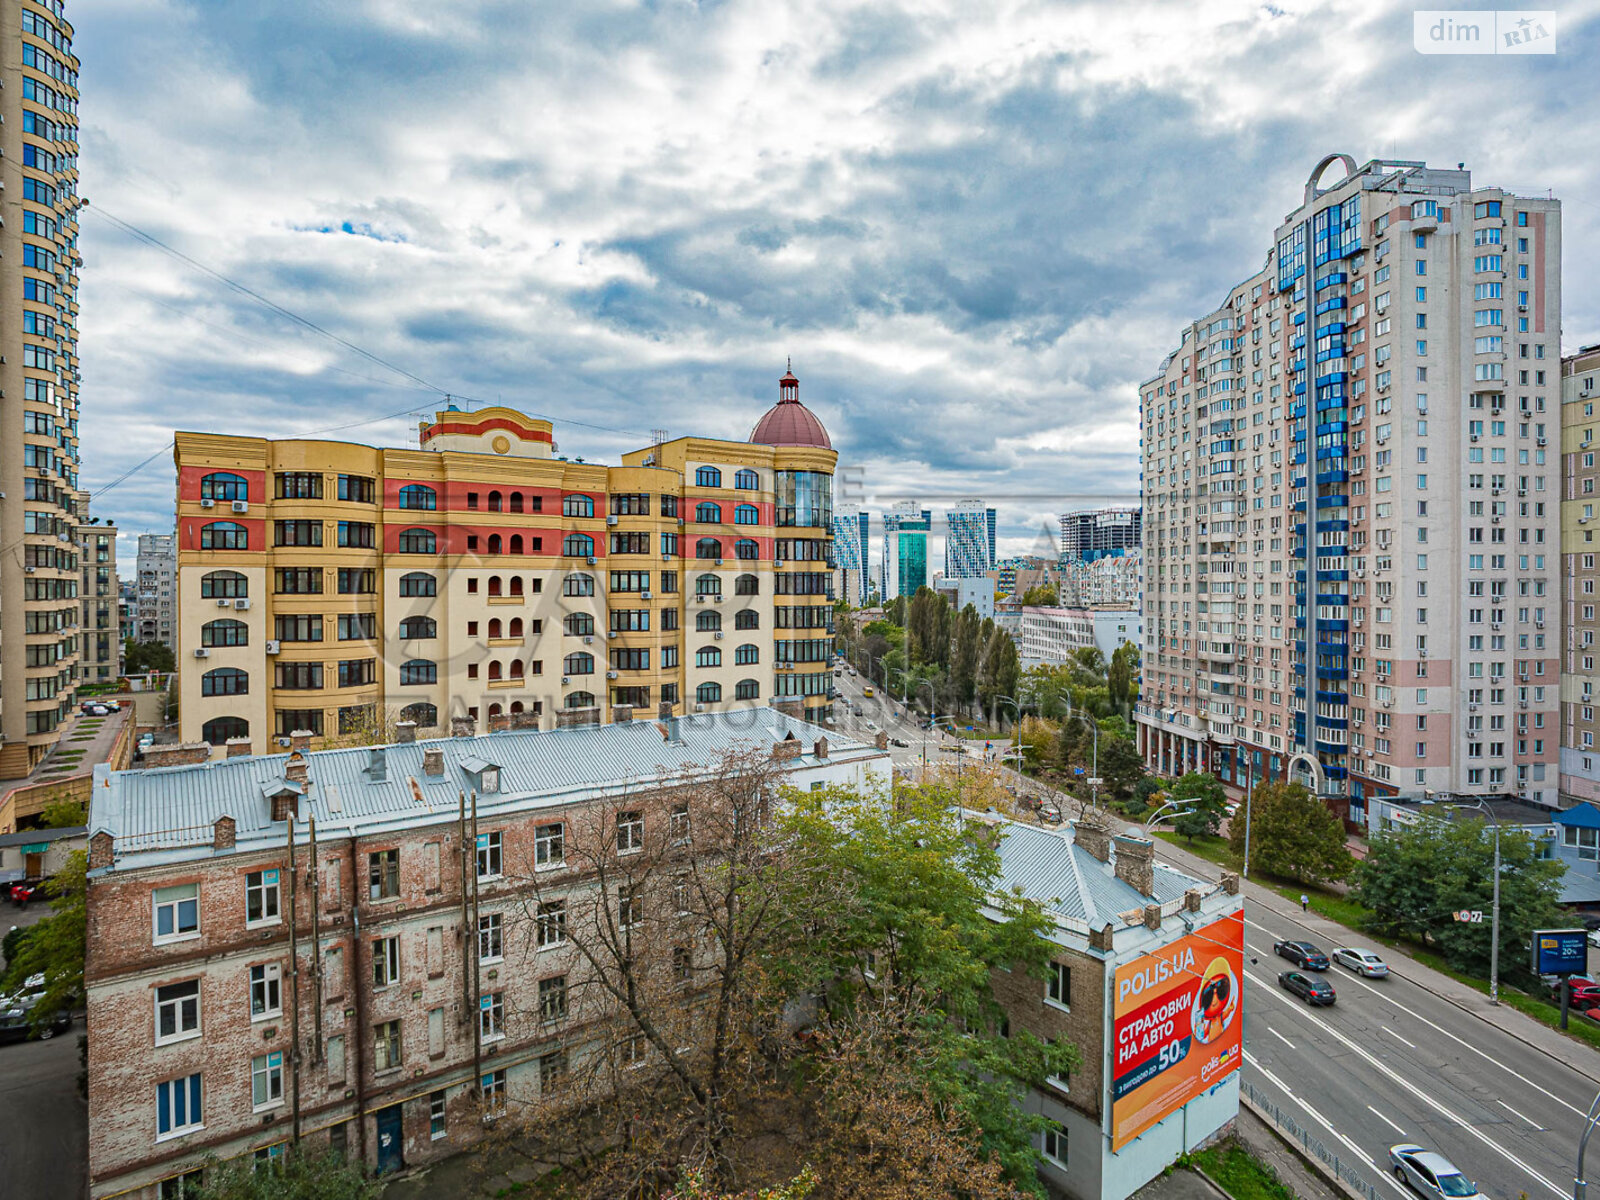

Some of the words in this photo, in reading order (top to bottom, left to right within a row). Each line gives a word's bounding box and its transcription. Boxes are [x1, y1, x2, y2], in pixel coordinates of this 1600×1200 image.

[1119, 947, 1195, 1004] POLIS.UA
[1119, 991, 1192, 1045] СТРАХОВКИ
[1119, 1041, 1139, 1065] НА
[1141, 1020, 1175, 1053] АВТО
